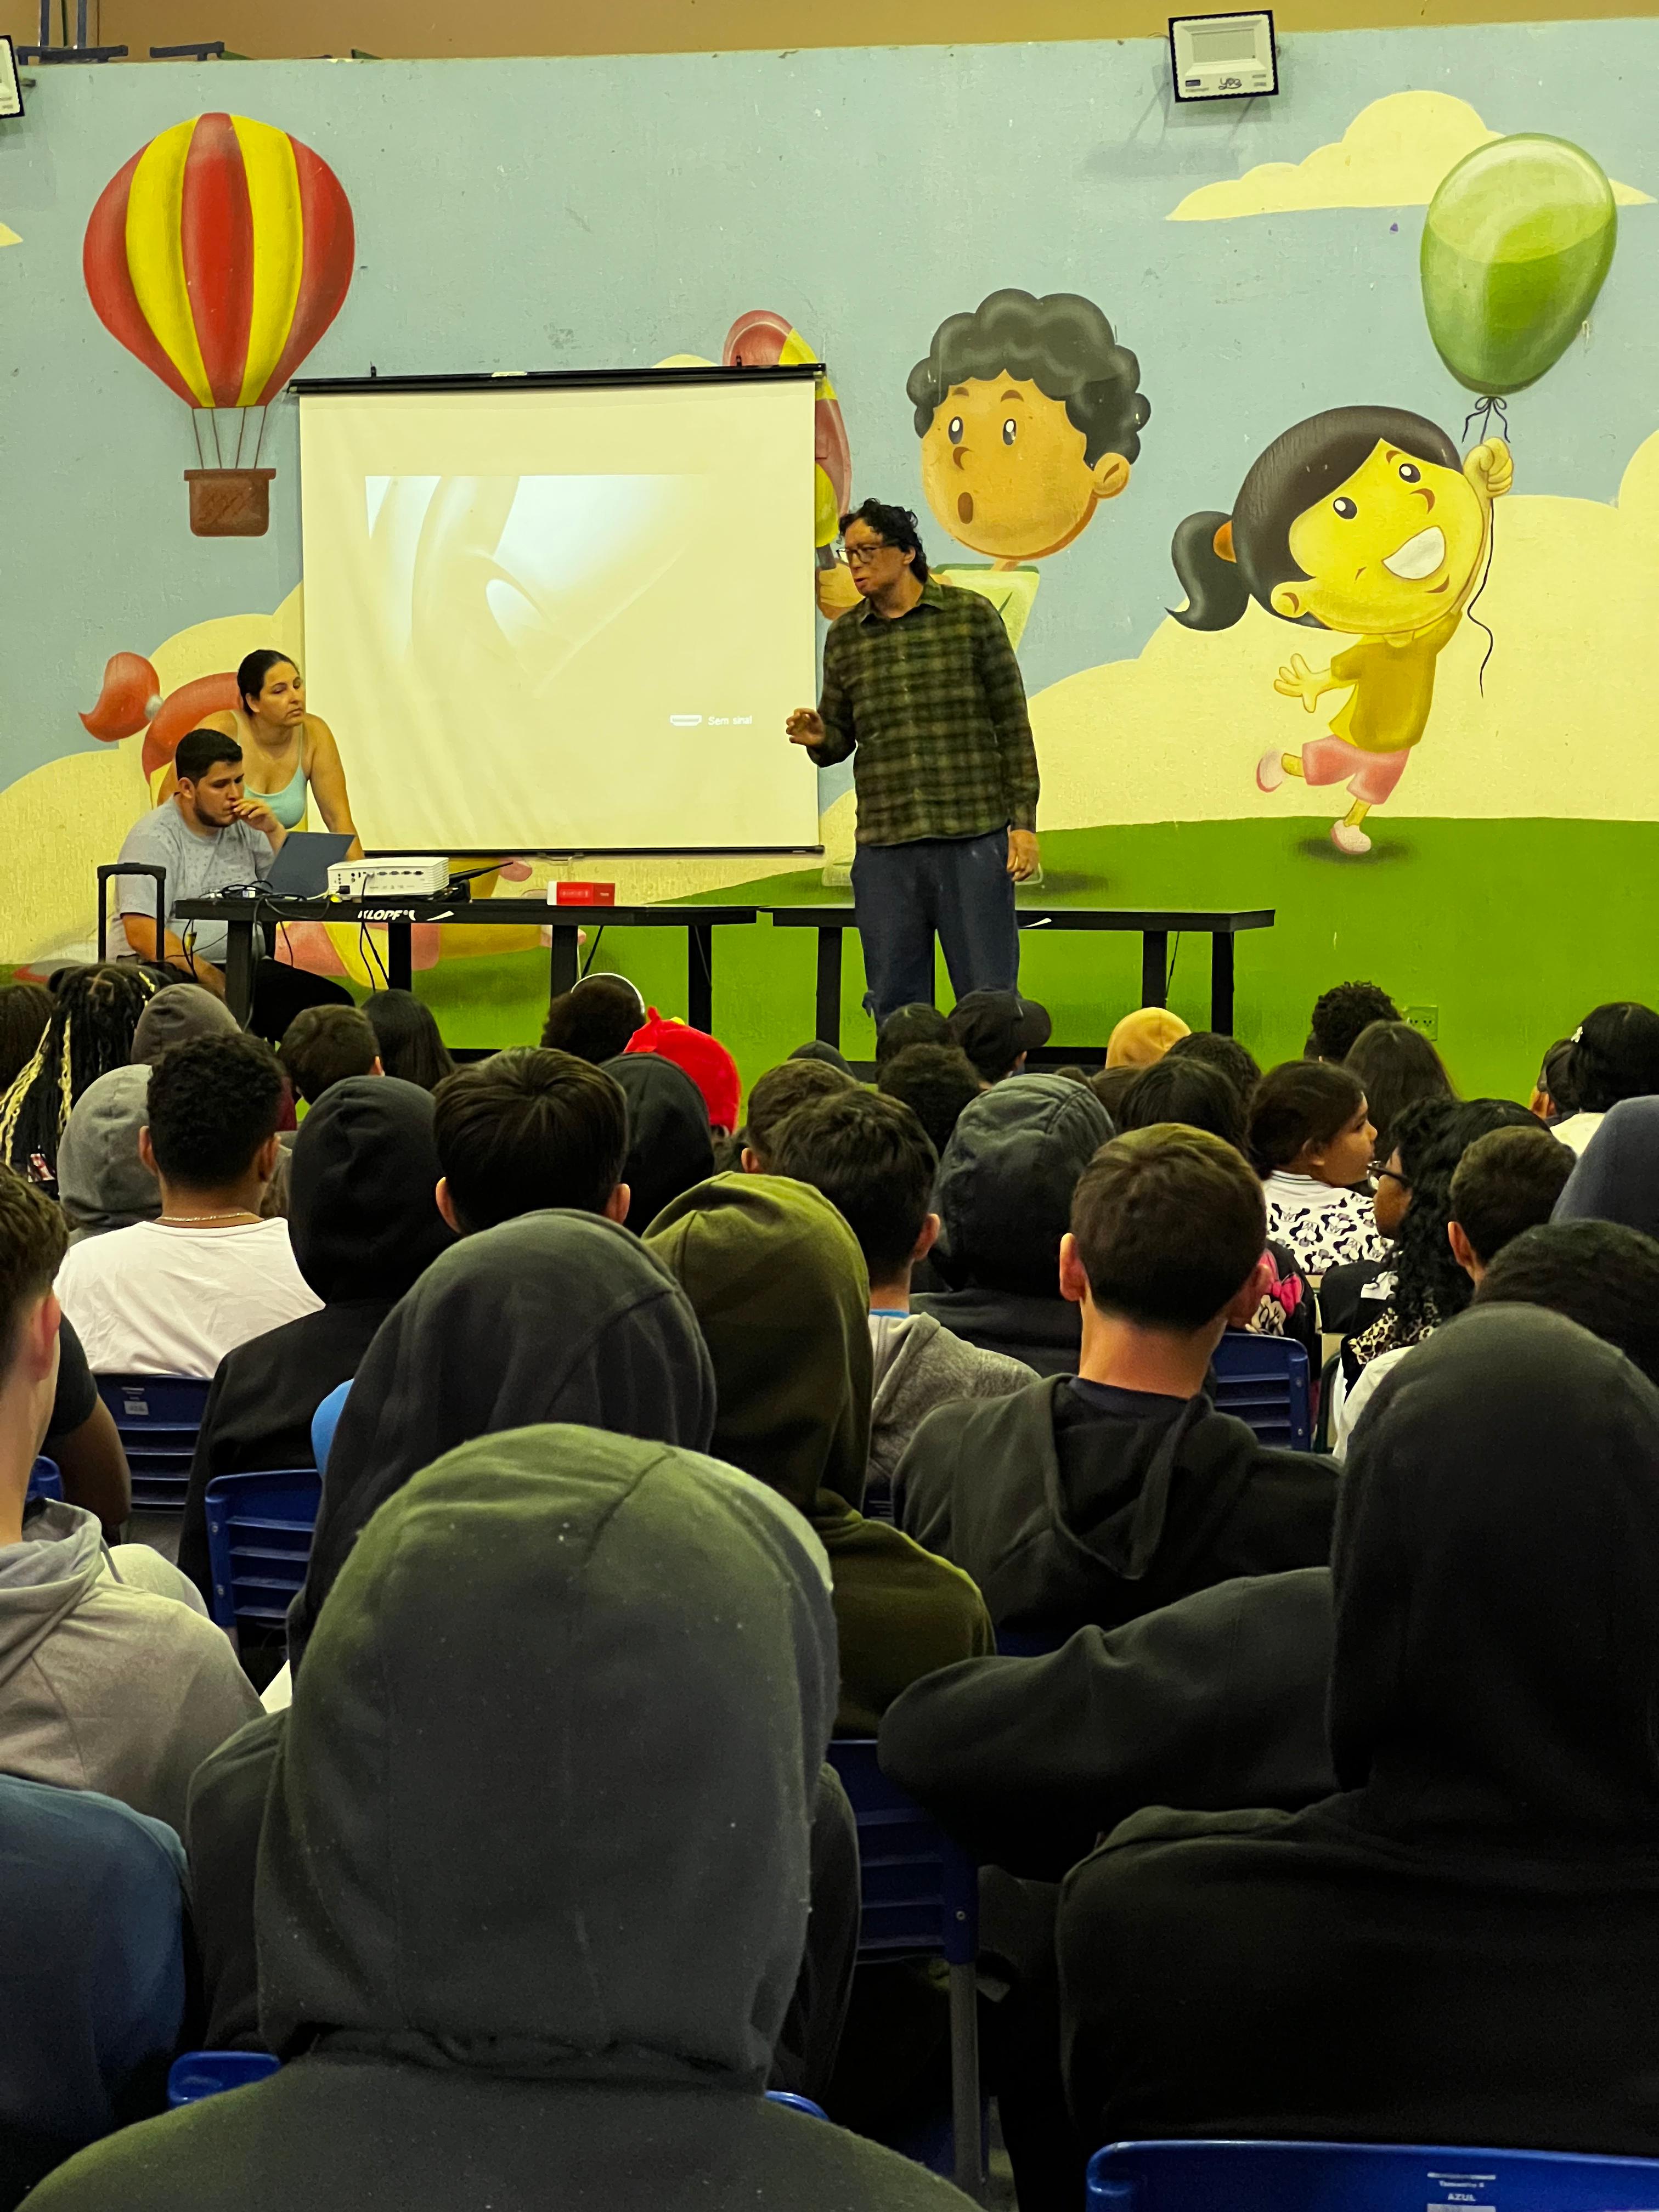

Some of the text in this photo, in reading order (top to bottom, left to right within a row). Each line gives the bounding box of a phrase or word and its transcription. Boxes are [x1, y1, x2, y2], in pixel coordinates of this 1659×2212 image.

[708, 715, 752, 725] Sem sinal
[358, 910, 403, 921] KLOPF
[1448, 2193, 1476, 2202] AZUL
